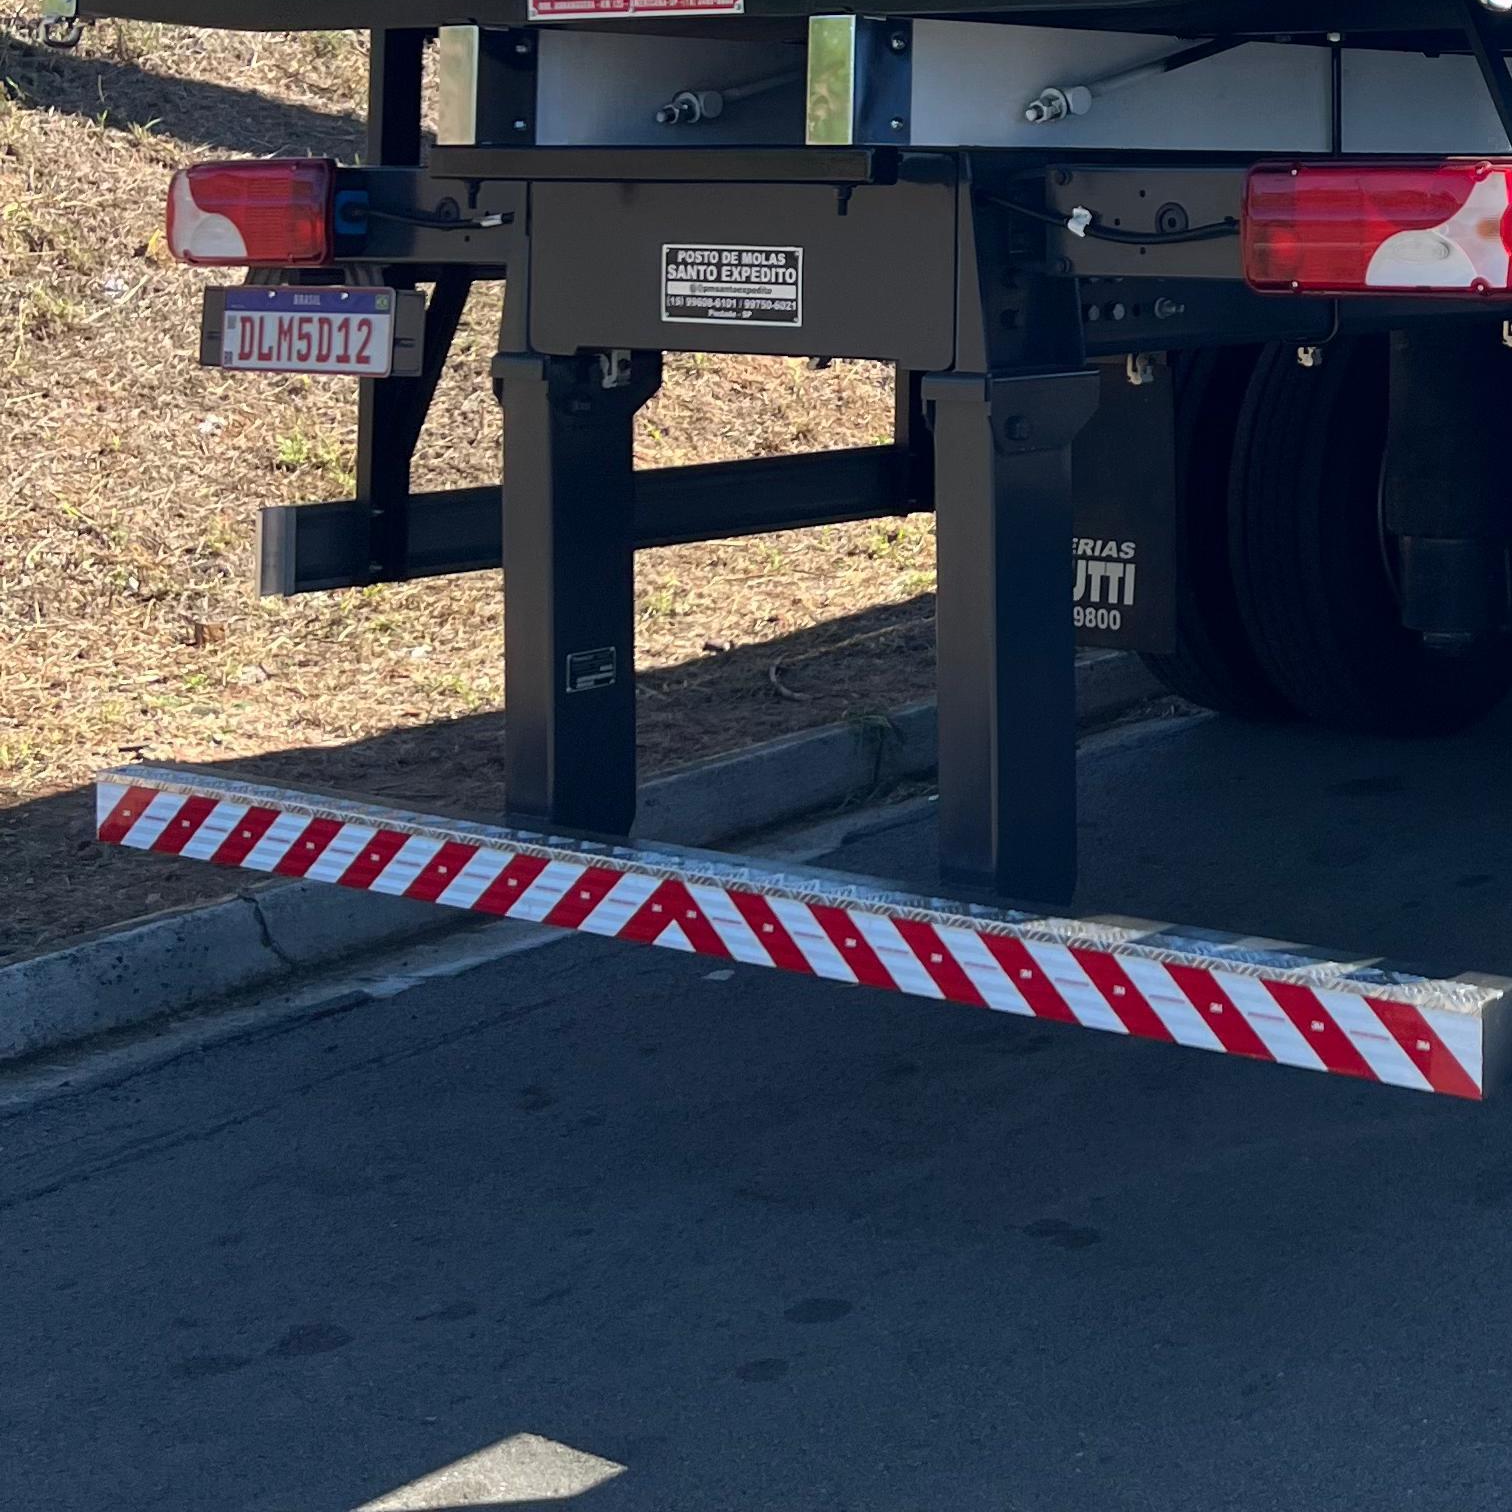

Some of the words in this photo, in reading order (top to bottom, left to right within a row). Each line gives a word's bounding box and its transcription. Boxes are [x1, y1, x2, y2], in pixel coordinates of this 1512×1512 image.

[677, 250, 719, 263] POSTO
[721, 251, 739, 264] DE
[741, 252, 786, 265] MOLAS
[667, 264, 718, 280] SANTO
[721, 266, 797, 283] EXPEDITO
[293, 294, 321, 306] BRASIL
[238, 315, 373, 364] DLM5D12
[1073, 606, 1121, 630] 9800
